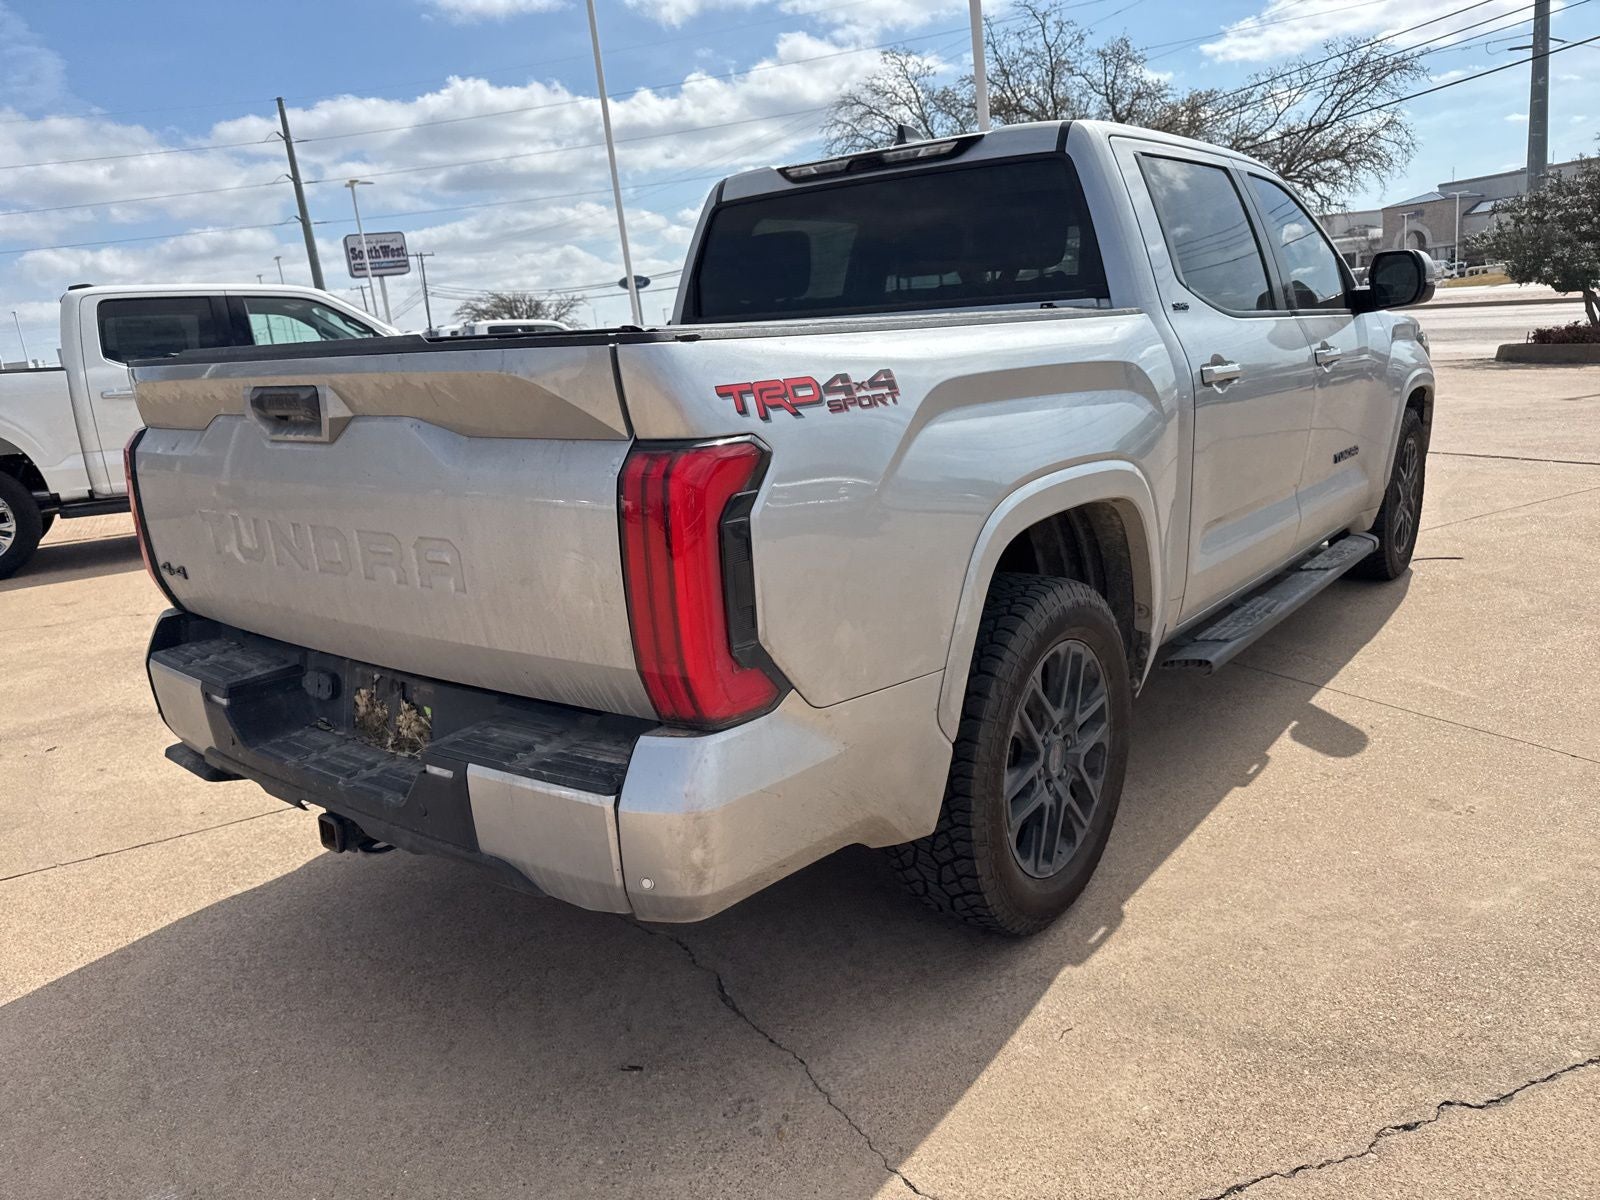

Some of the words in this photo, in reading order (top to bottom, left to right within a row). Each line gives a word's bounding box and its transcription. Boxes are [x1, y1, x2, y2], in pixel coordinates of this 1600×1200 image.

[715, 376, 824, 421] TRD
[822, 368, 899, 398] 4x4
[826, 390, 900, 414] SPORT
[199, 509, 466, 594] TUNDRA
